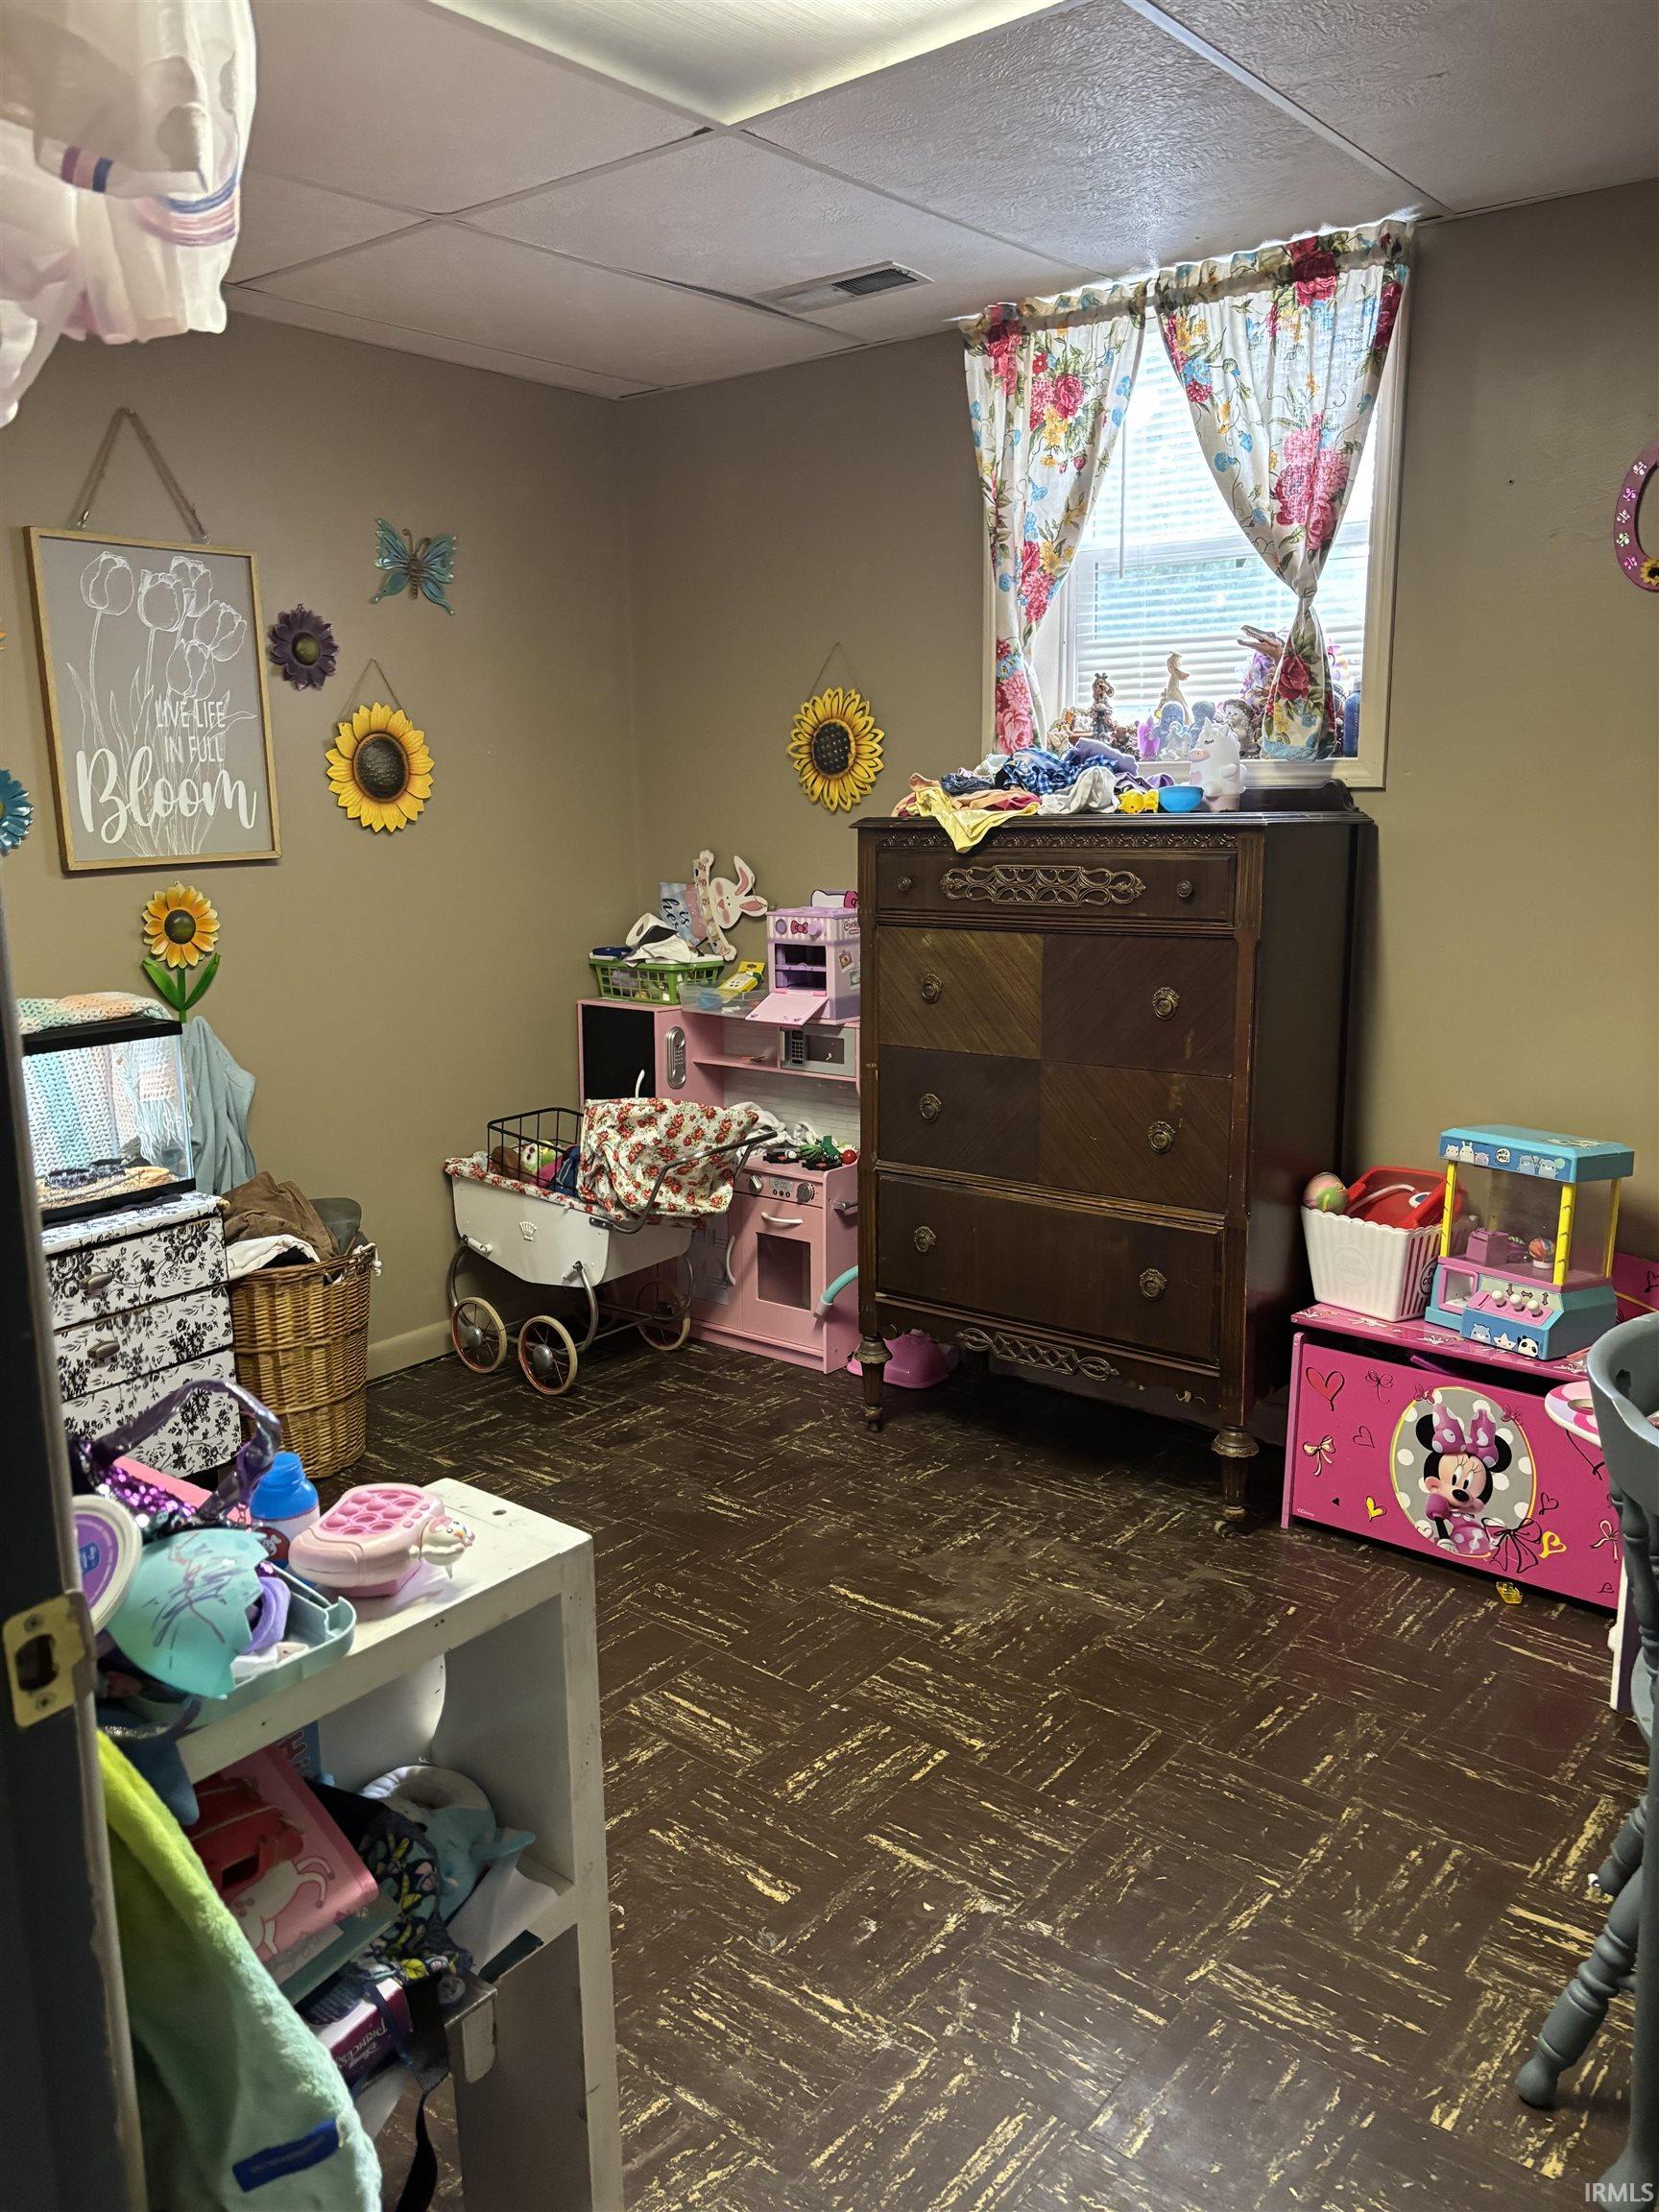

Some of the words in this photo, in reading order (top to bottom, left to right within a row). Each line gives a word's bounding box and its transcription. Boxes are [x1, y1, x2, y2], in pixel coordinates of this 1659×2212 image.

[156, 700, 190, 729] LIVE
[195, 700, 226, 730] LIFE
[164, 735, 183, 763] IN
[188, 735, 225, 763] FULL
[76, 745, 257, 844] Bloom
